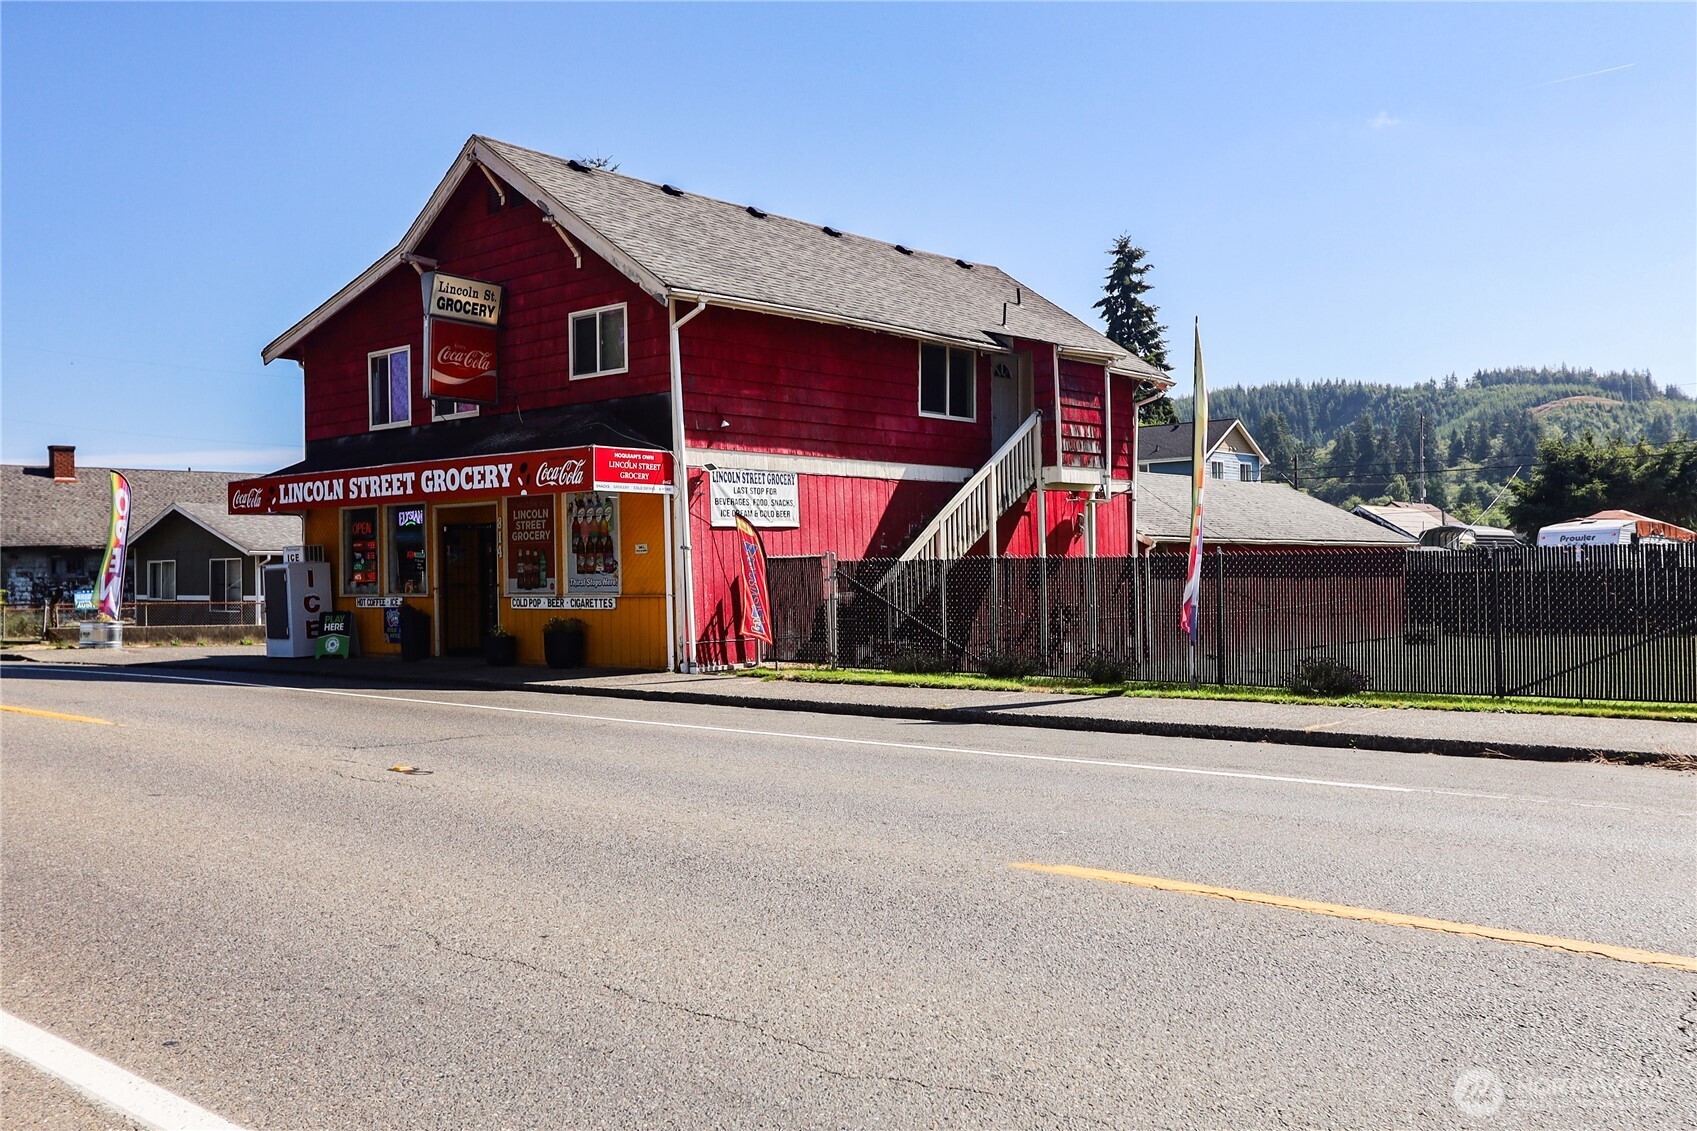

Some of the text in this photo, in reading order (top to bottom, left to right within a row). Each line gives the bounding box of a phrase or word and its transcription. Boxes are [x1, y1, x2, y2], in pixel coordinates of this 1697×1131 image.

[438, 281, 497, 302] Lincoln St.
[437, 296, 496, 318] GROCERY
[614, 452, 641, 460] HOQUIAM'S
[608, 460, 661, 471] LINCOLN STREET
[620, 471, 650, 480] GROCERY
[712, 470, 795, 486] LINCOLN STREET GROCERY
[279, 463, 513, 504] LINCOLN STREET GROCERY
[733, 486, 748, 494] LAST
[750, 487, 765, 495] STOP
[715, 498, 796, 508] BEVERAGES, FOOD, SNACKS,
[398, 510, 423, 526] ELYSIAN
[513, 509, 549, 520] LINCOLN
[760, 510, 775, 518] COLD
[776, 510, 791, 518] BEER
[352, 522, 371, 534] OPEN
[515, 520, 546, 530] STREET
[512, 530, 551, 541] GROCERY
[1560, 534, 1596, 542] Prowler
[287, 554, 300, 562] ICE
[586, 577, 602, 588] Stops
[303, 569, 321, 639] ICE
[357, 598, 399, 606] HOT COFFEE ICE
[512, 597, 613, 608] COLD POP BEER CIGARETTES
[325, 614, 345, 623] PLAY
[324, 623, 344, 631] HERE
